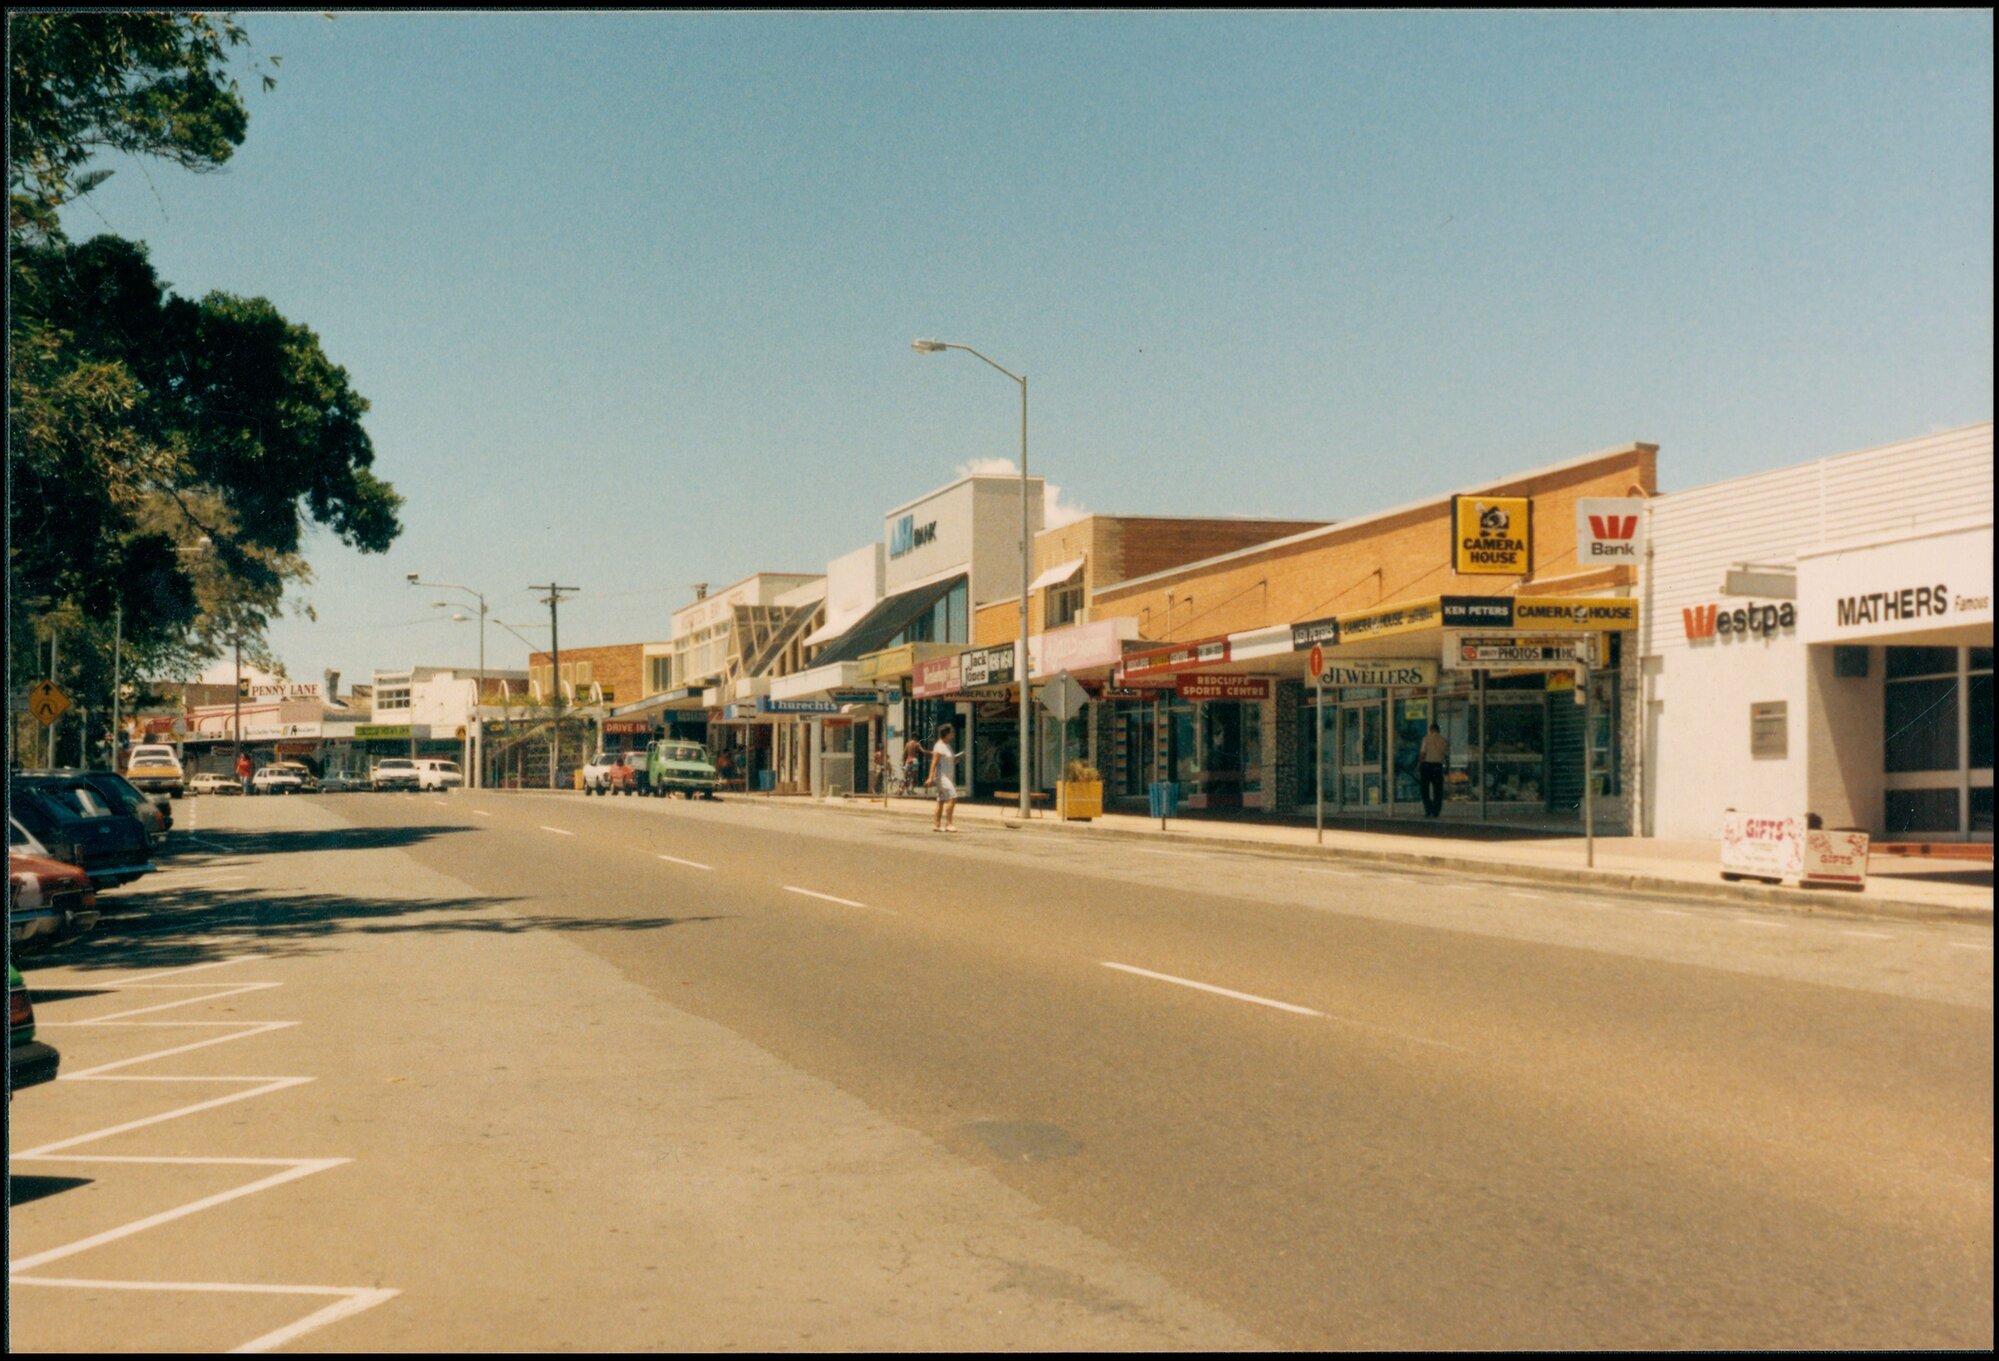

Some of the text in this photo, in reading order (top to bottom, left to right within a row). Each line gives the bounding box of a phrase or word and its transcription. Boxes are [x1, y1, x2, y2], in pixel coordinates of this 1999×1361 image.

[1463, 538, 1524, 551] CAMERA
[1591, 542, 1635, 556] Bank
[1470, 551, 1518, 564] HOUSE
[1837, 584, 1948, 627] MATHERS
[1444, 605, 1466, 616] KEN
[1468, 605, 1510, 617] PETERS
[1517, 605, 1573, 618] CAMERA
[1589, 606, 1633, 620] HOUSE
[1683, 602, 1795, 638] Westpa
[1499, 647, 1540, 659] PHOTOS
[966, 651, 987, 671] Jack
[1197, 676, 1249, 685] REDCLIFFE
[1322, 667, 1423, 685] JEWELLERS
[252, 684, 318, 696] PENNY LANE
[1183, 686, 1264, 696] SPORTS CENTRE
[606, 722, 633, 733] DRIVE
